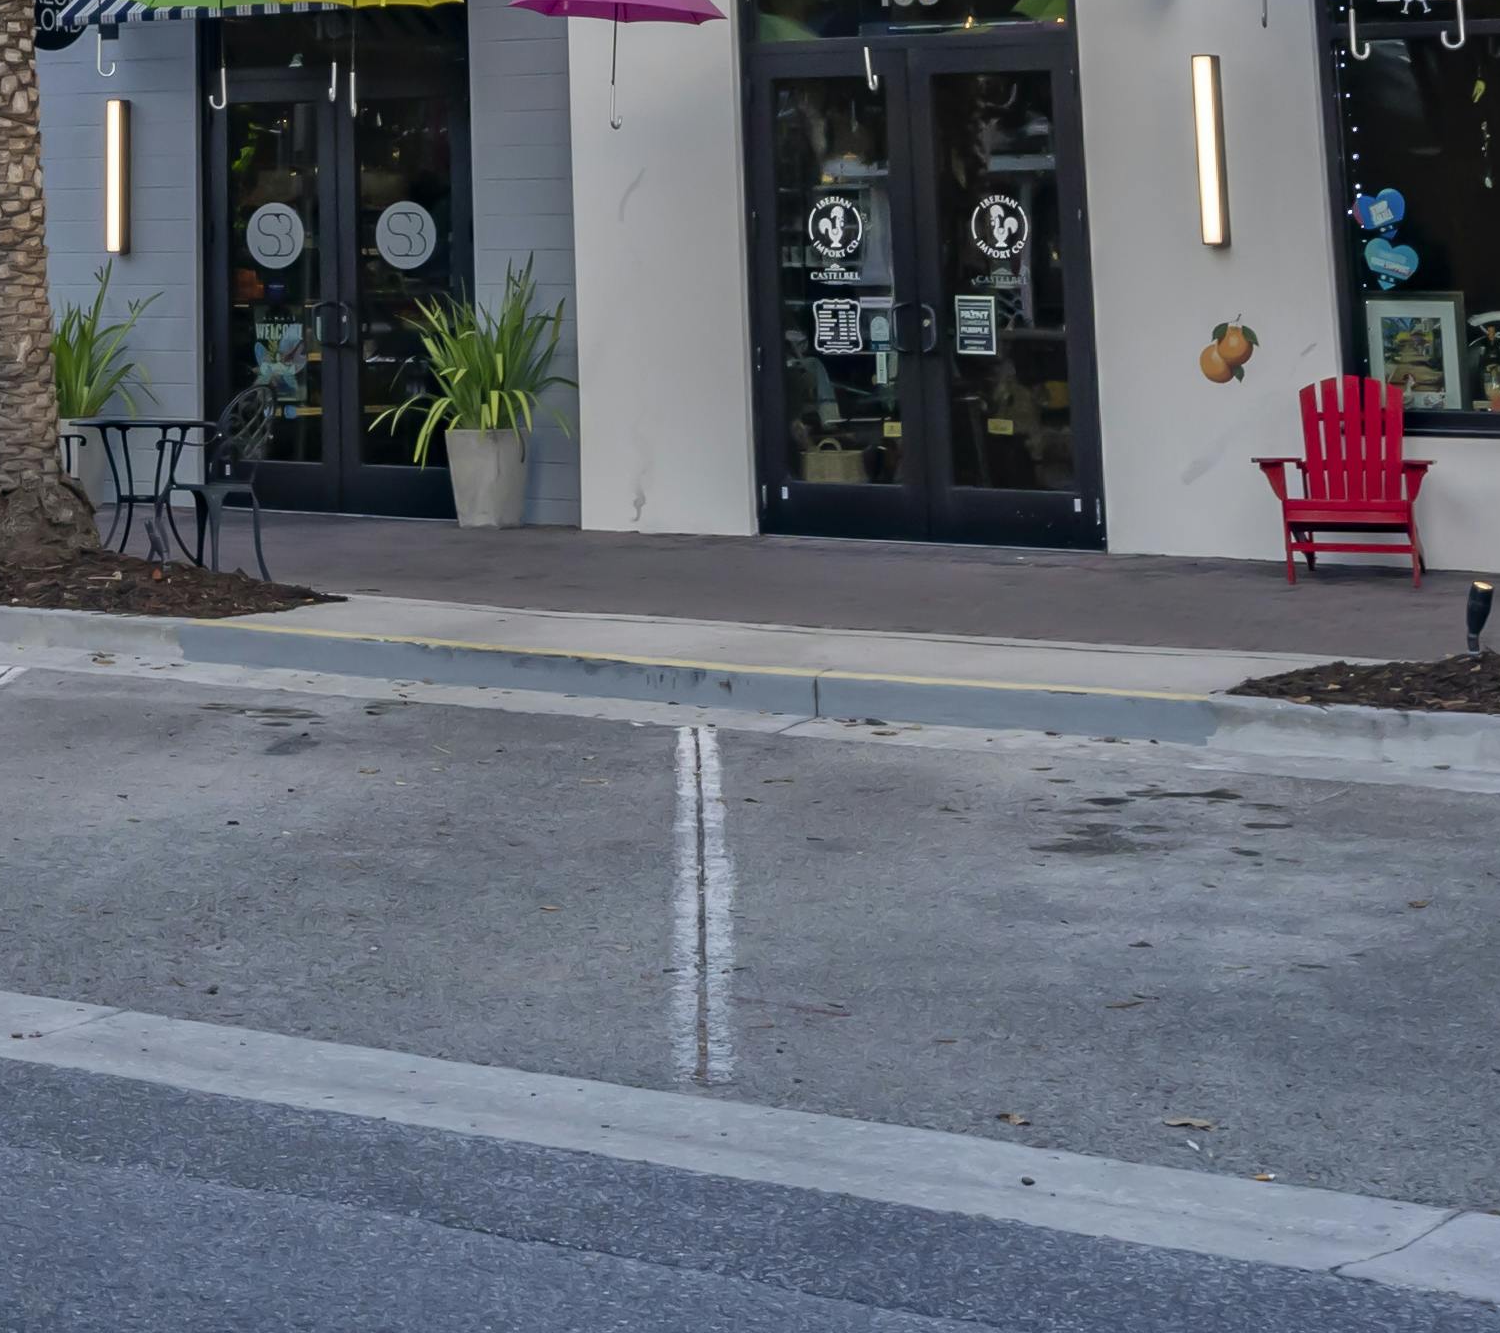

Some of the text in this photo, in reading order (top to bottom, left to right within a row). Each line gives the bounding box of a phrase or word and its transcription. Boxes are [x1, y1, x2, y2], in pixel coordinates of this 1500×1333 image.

[816, 196, 852, 210] IBERIAN
[979, 195, 1018, 209] IBERIAN
[813, 240, 846, 258] IMPORT
[976, 240, 1011, 259] IMPORT
[811, 272, 860, 281] CASTELBEL
